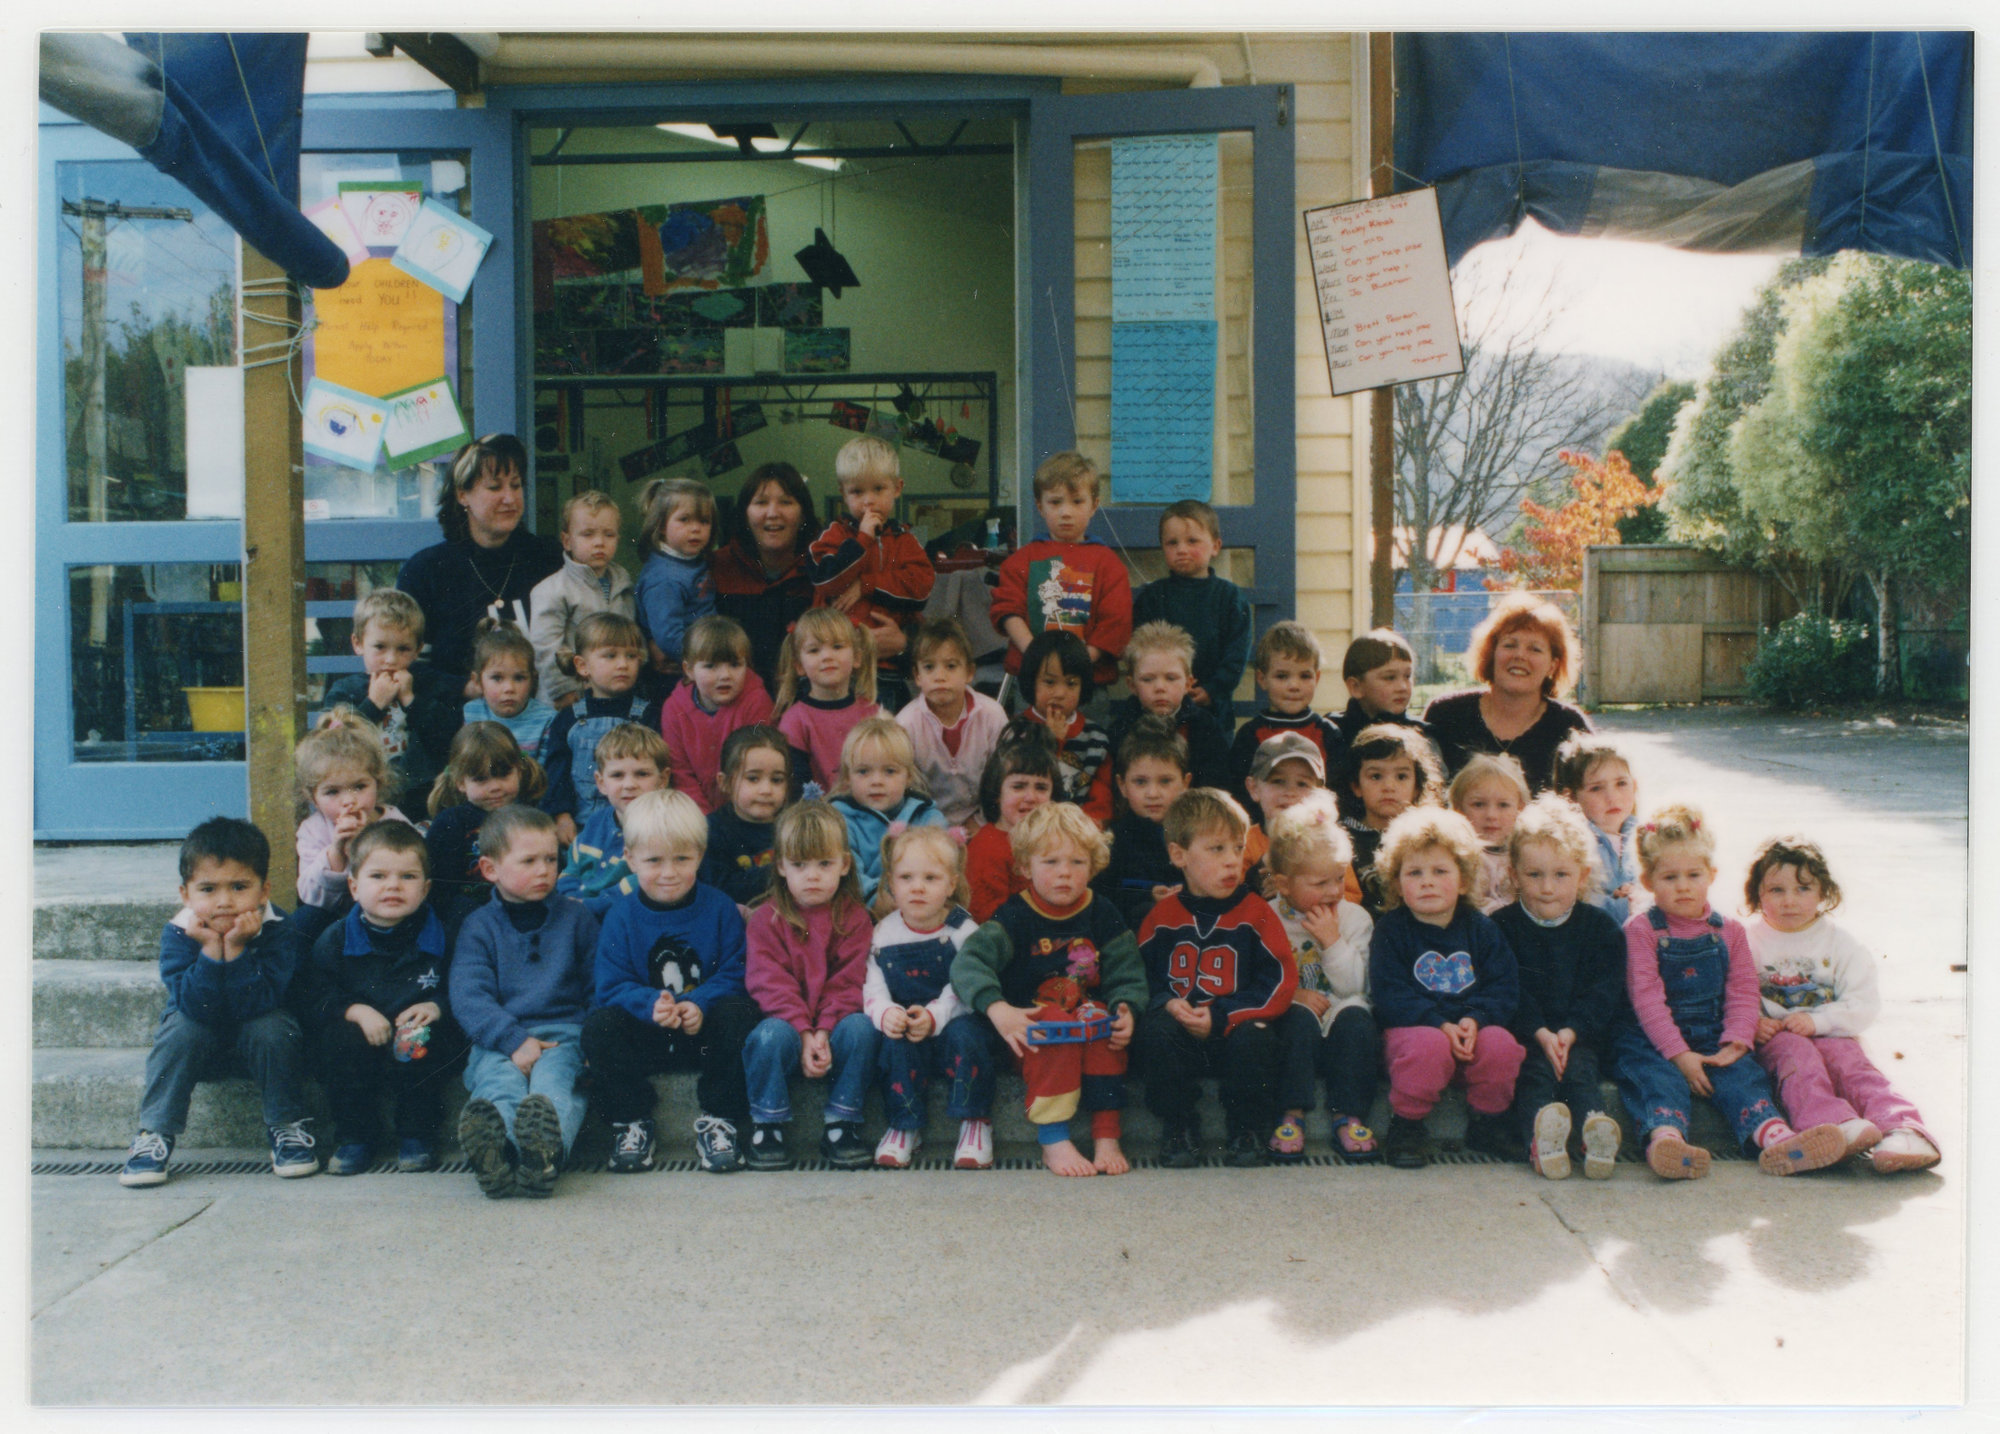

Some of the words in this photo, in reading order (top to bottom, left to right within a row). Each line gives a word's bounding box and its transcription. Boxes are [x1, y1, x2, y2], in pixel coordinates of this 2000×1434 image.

[1344, 257, 1362, 267] Can
[1365, 255, 1381, 265] you
[1346, 274, 1362, 283] Can
[1365, 271, 1380, 282] you
[374, 279, 418, 289] CHILDREN
[339, 296, 362, 304] need
[359, 321, 379, 333] Help
[1355, 339, 1372, 348] Can
[1358, 354, 1374, 363] Can
[1167, 940, 1238, 1003] 99
